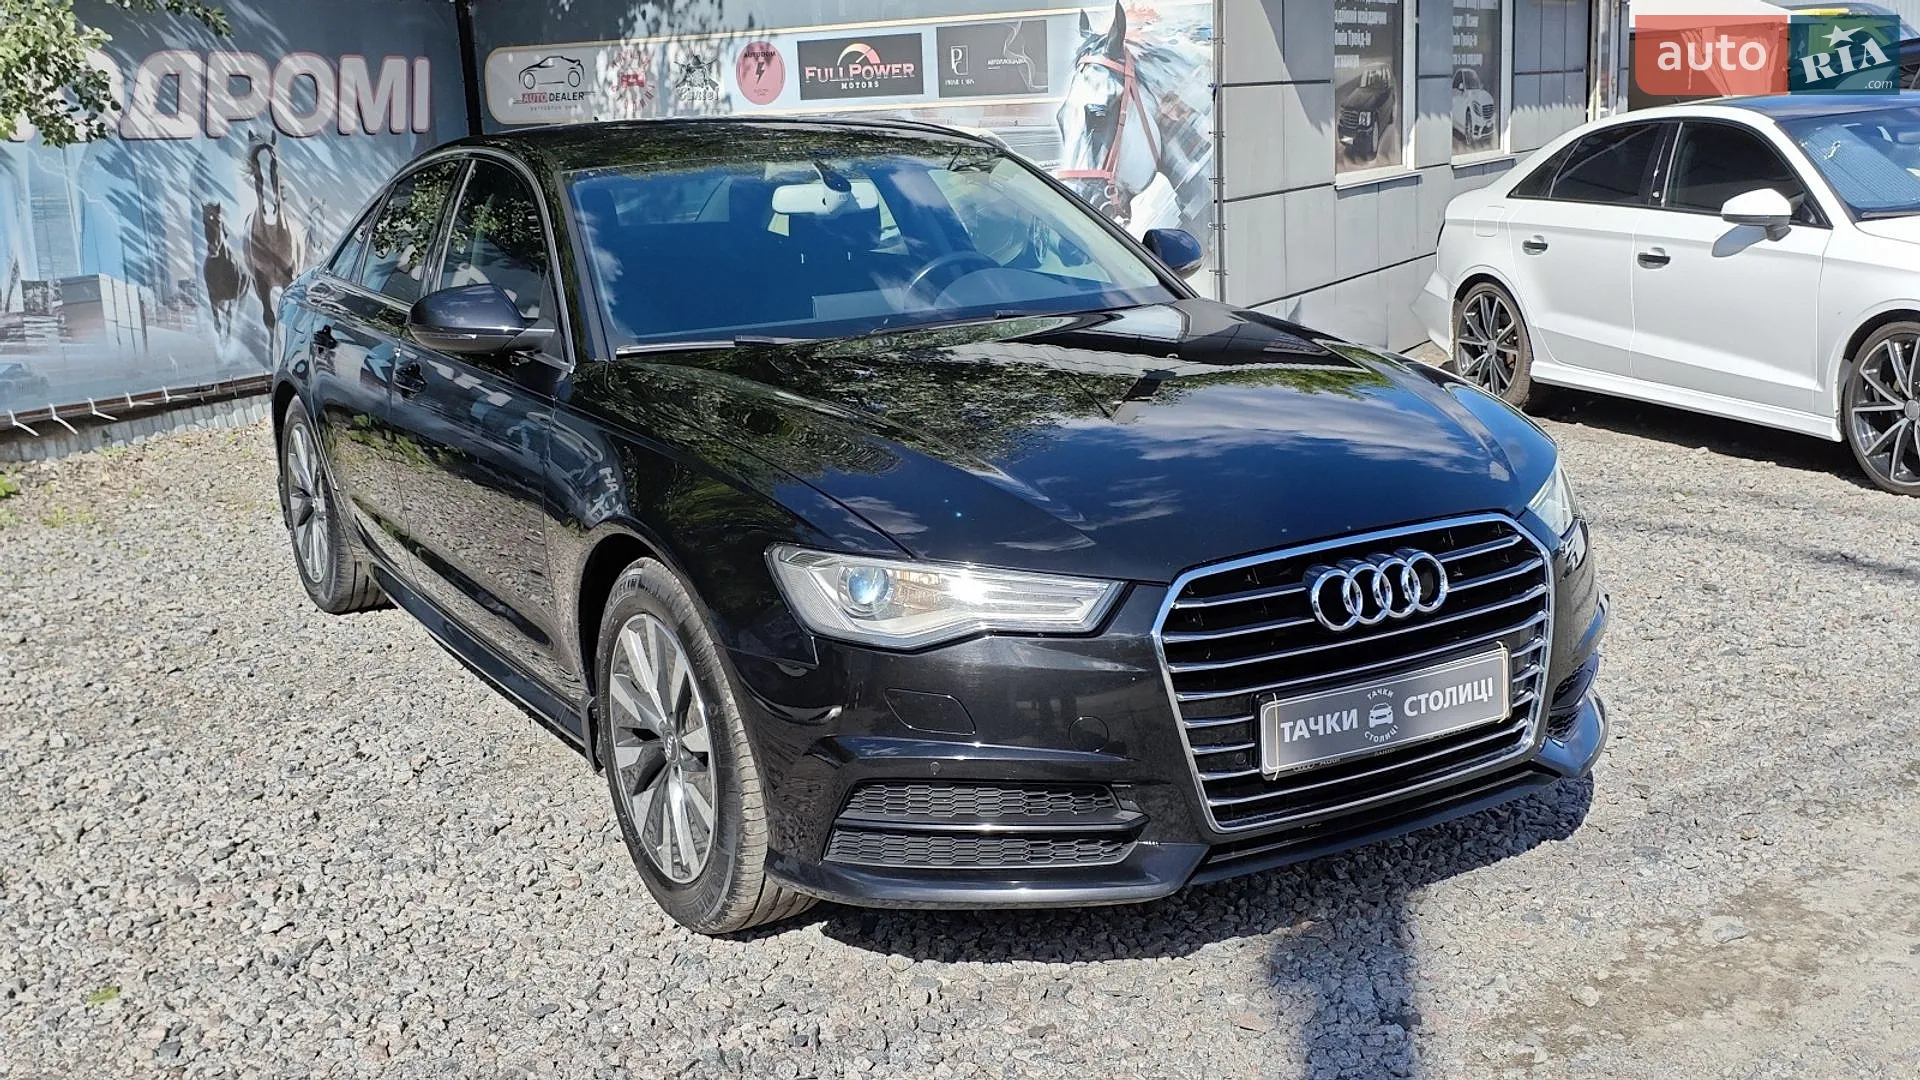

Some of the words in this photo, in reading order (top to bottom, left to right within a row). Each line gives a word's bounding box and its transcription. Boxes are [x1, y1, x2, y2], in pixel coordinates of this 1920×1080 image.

[841, 81, 880, 90] MOTORS
[549, 91, 585, 102] DEALER
[1368, 688, 1394, 700] ТАЧКИ
[1280, 708, 1359, 743] ТАЧКИ
[1403, 677, 1493, 717] СТОЛИЦІ
[1364, 724, 1399, 742] СТОЛИЦІ
